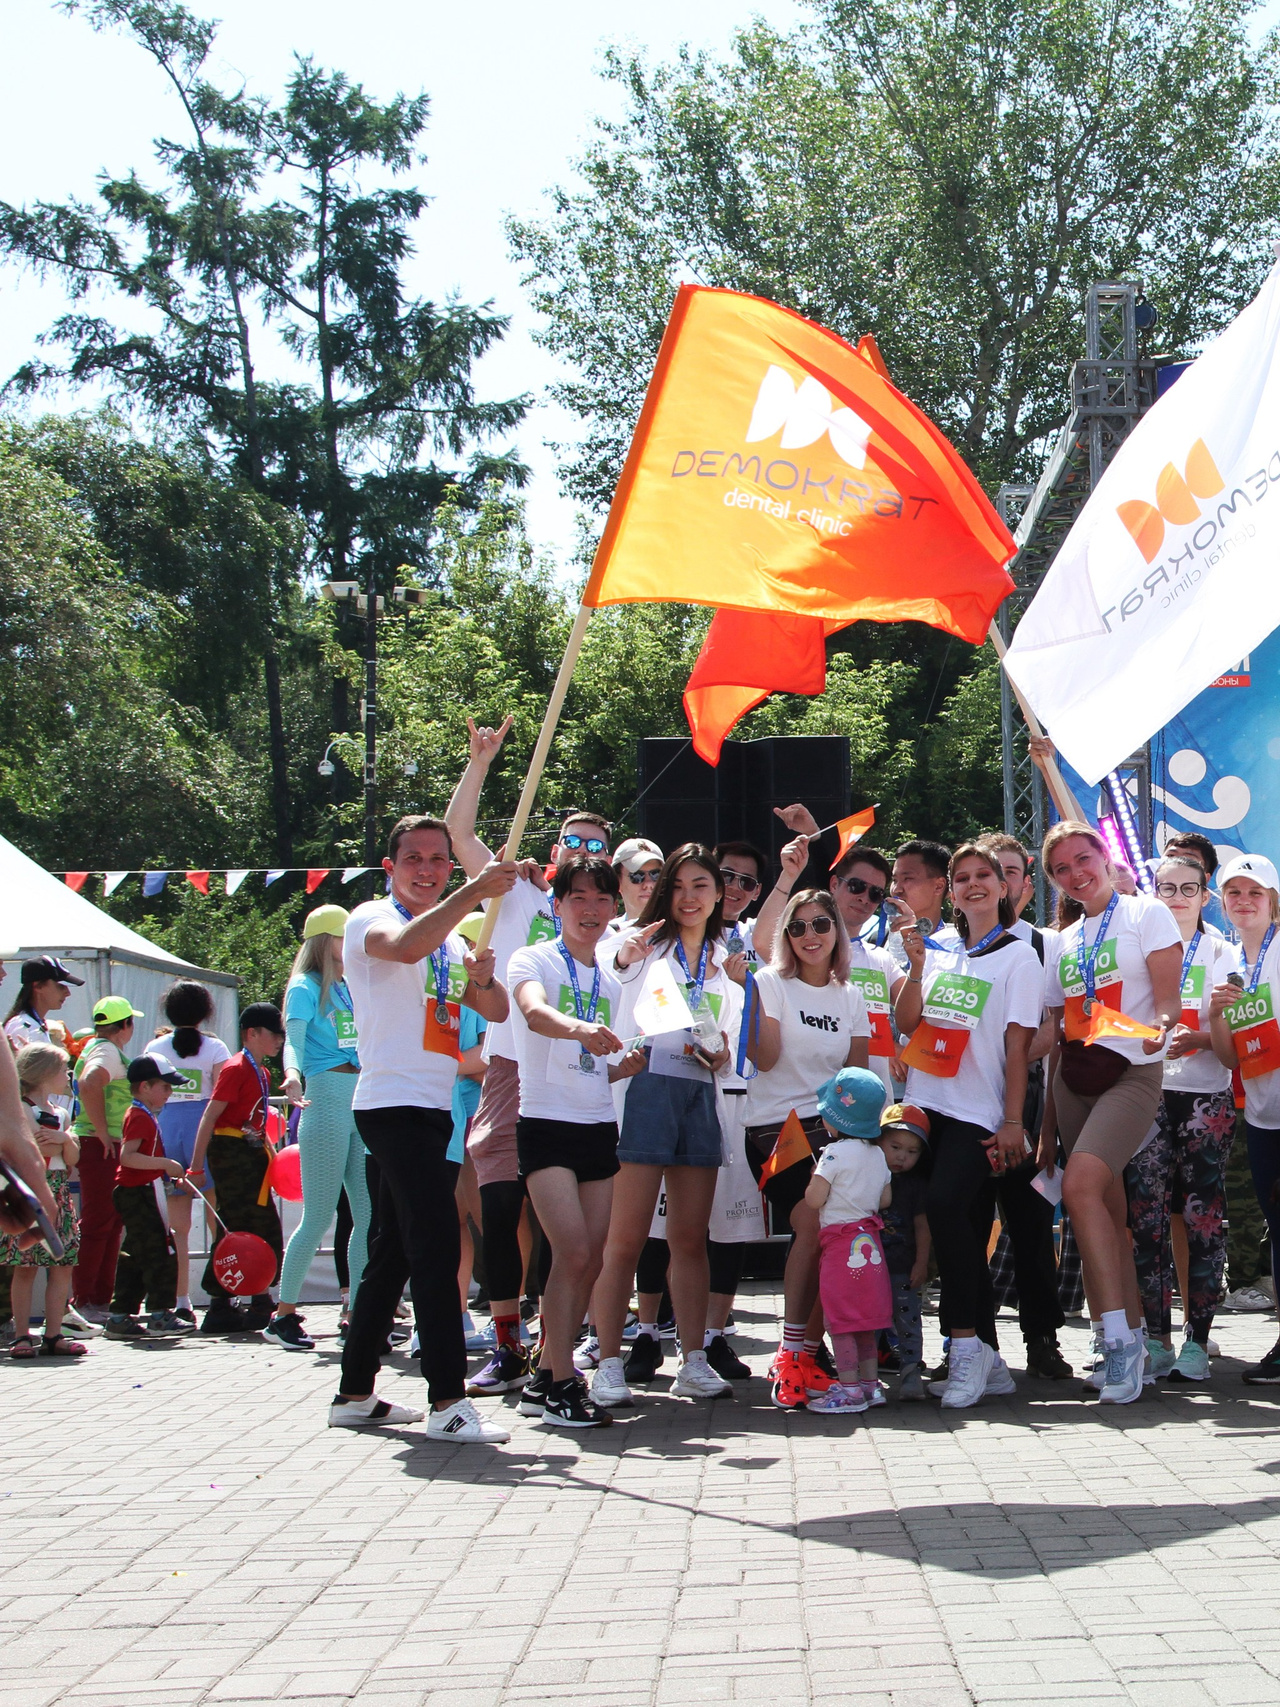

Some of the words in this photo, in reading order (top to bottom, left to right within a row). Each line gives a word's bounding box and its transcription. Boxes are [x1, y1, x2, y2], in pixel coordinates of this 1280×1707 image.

[724, 488, 790, 521] dental
[797, 507, 852, 538] clinic
[932, 986, 979, 1009] 2829
[1228, 999, 1268, 1024] 2460
[823, 1104, 855, 1128] LEPHANT
